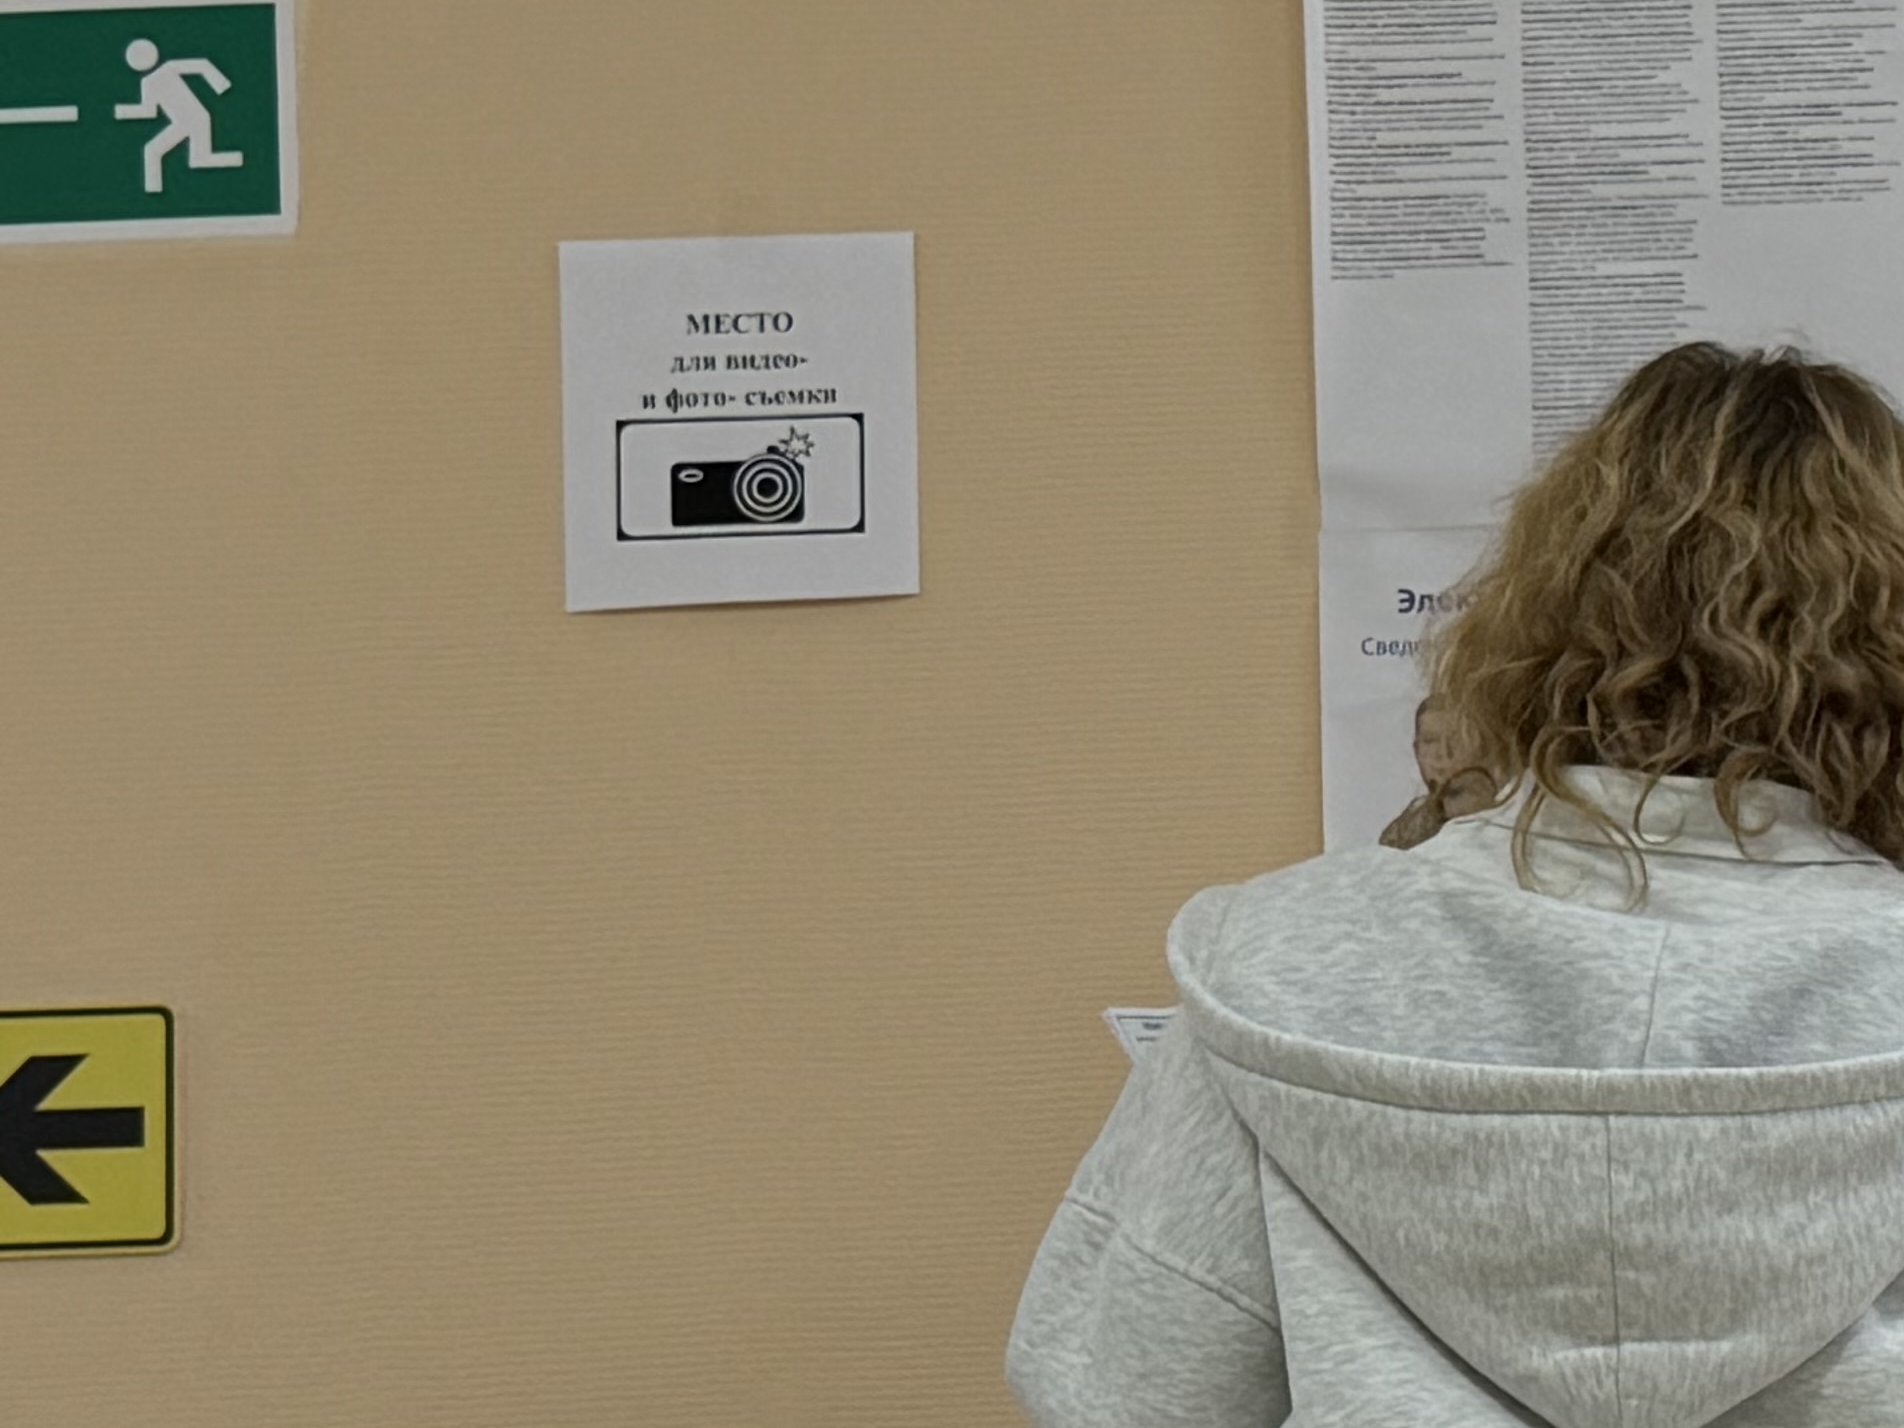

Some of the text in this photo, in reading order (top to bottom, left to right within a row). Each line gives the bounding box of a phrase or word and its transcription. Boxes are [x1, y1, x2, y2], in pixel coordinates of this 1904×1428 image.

[687, 312, 794, 335] МЕСТО
[671, 354, 808, 373] для видео-
[642, 387, 837, 414] и фото- съемки
